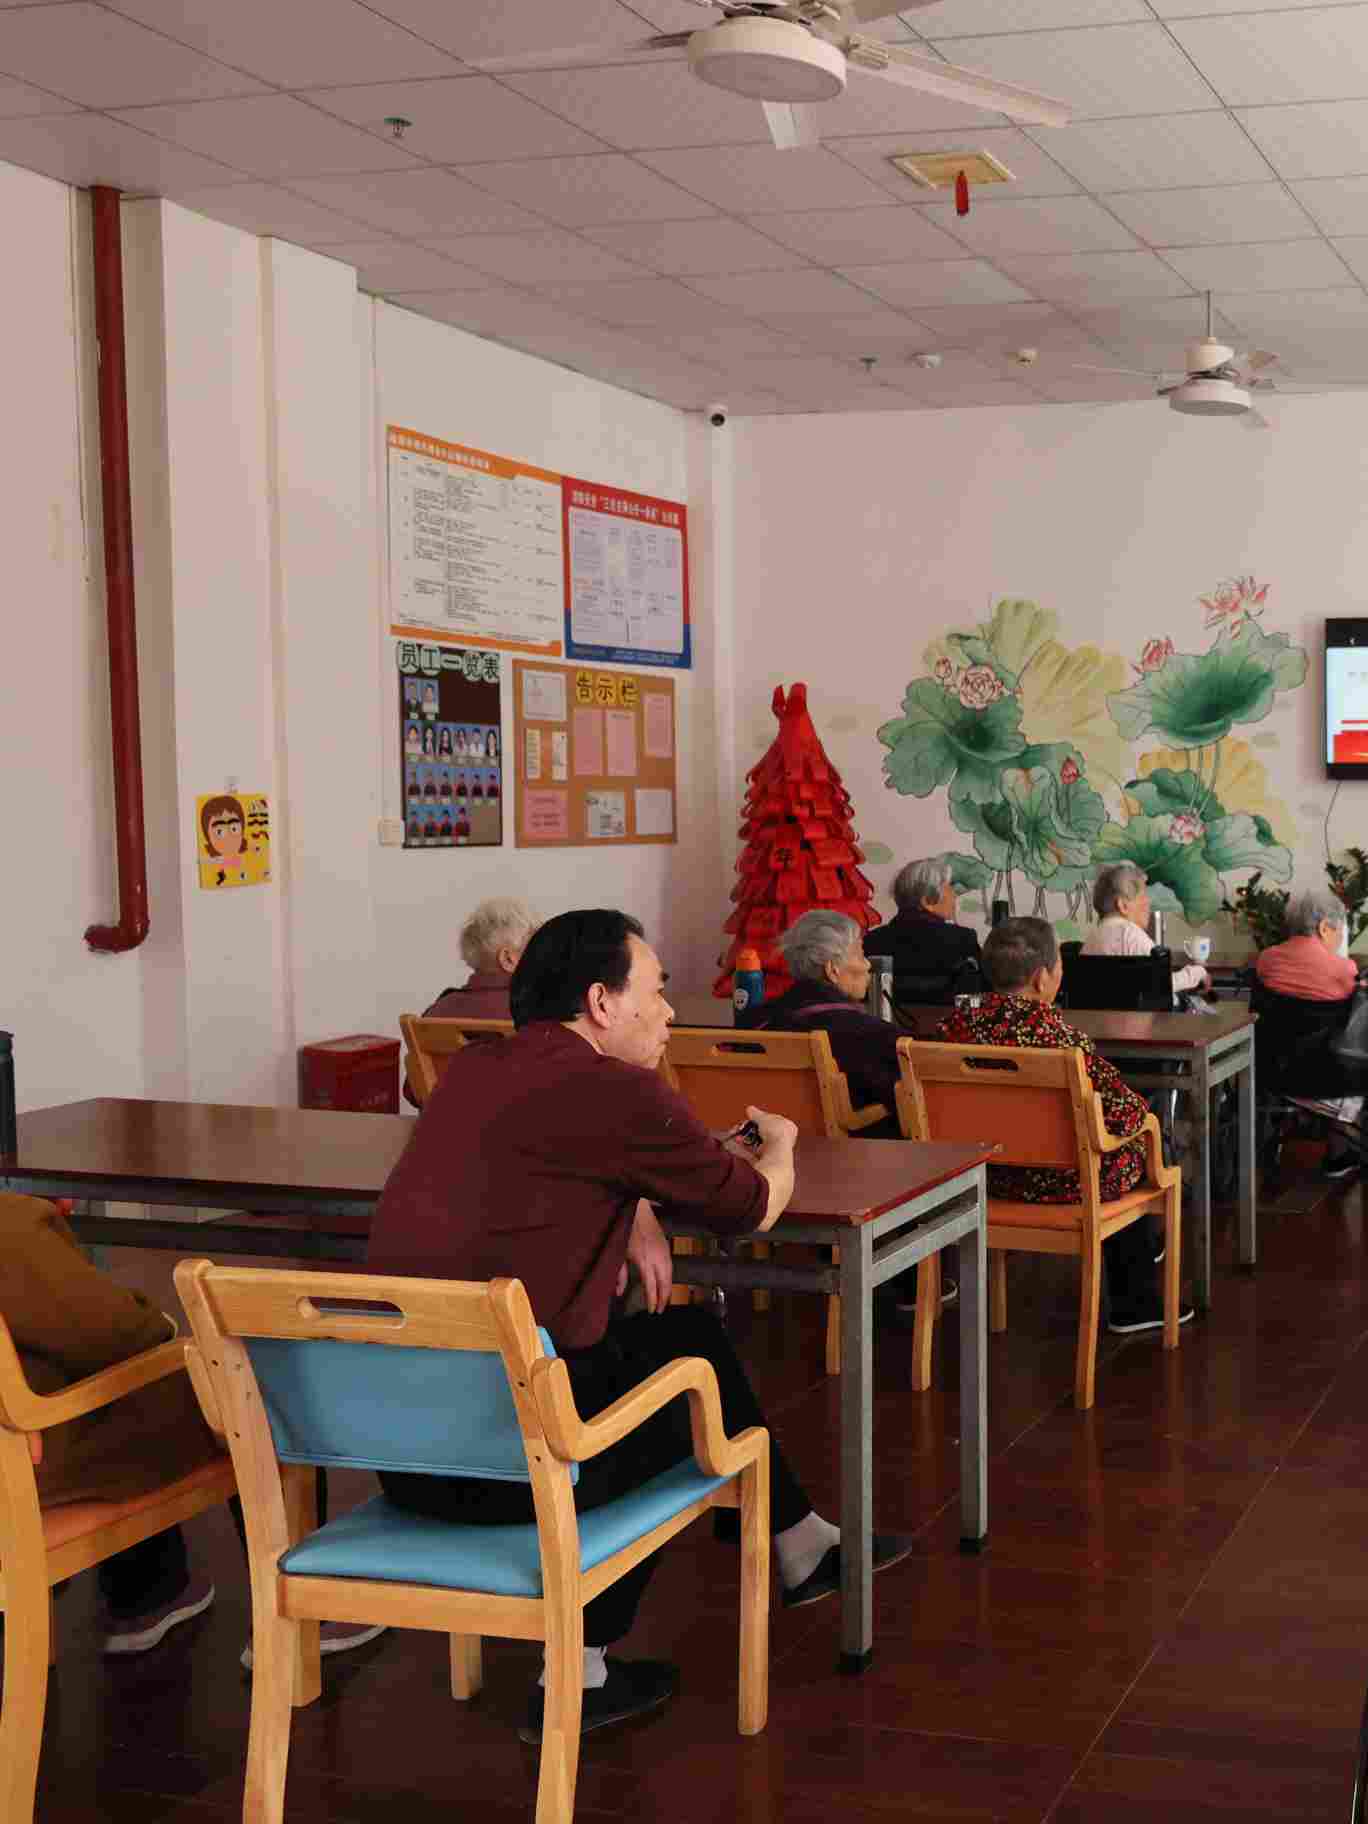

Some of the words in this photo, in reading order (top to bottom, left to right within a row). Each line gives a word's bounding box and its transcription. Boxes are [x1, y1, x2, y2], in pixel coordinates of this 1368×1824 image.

[400, 642, 499, 680] 员工一览表
[576, 672, 640, 705] 告示栏
